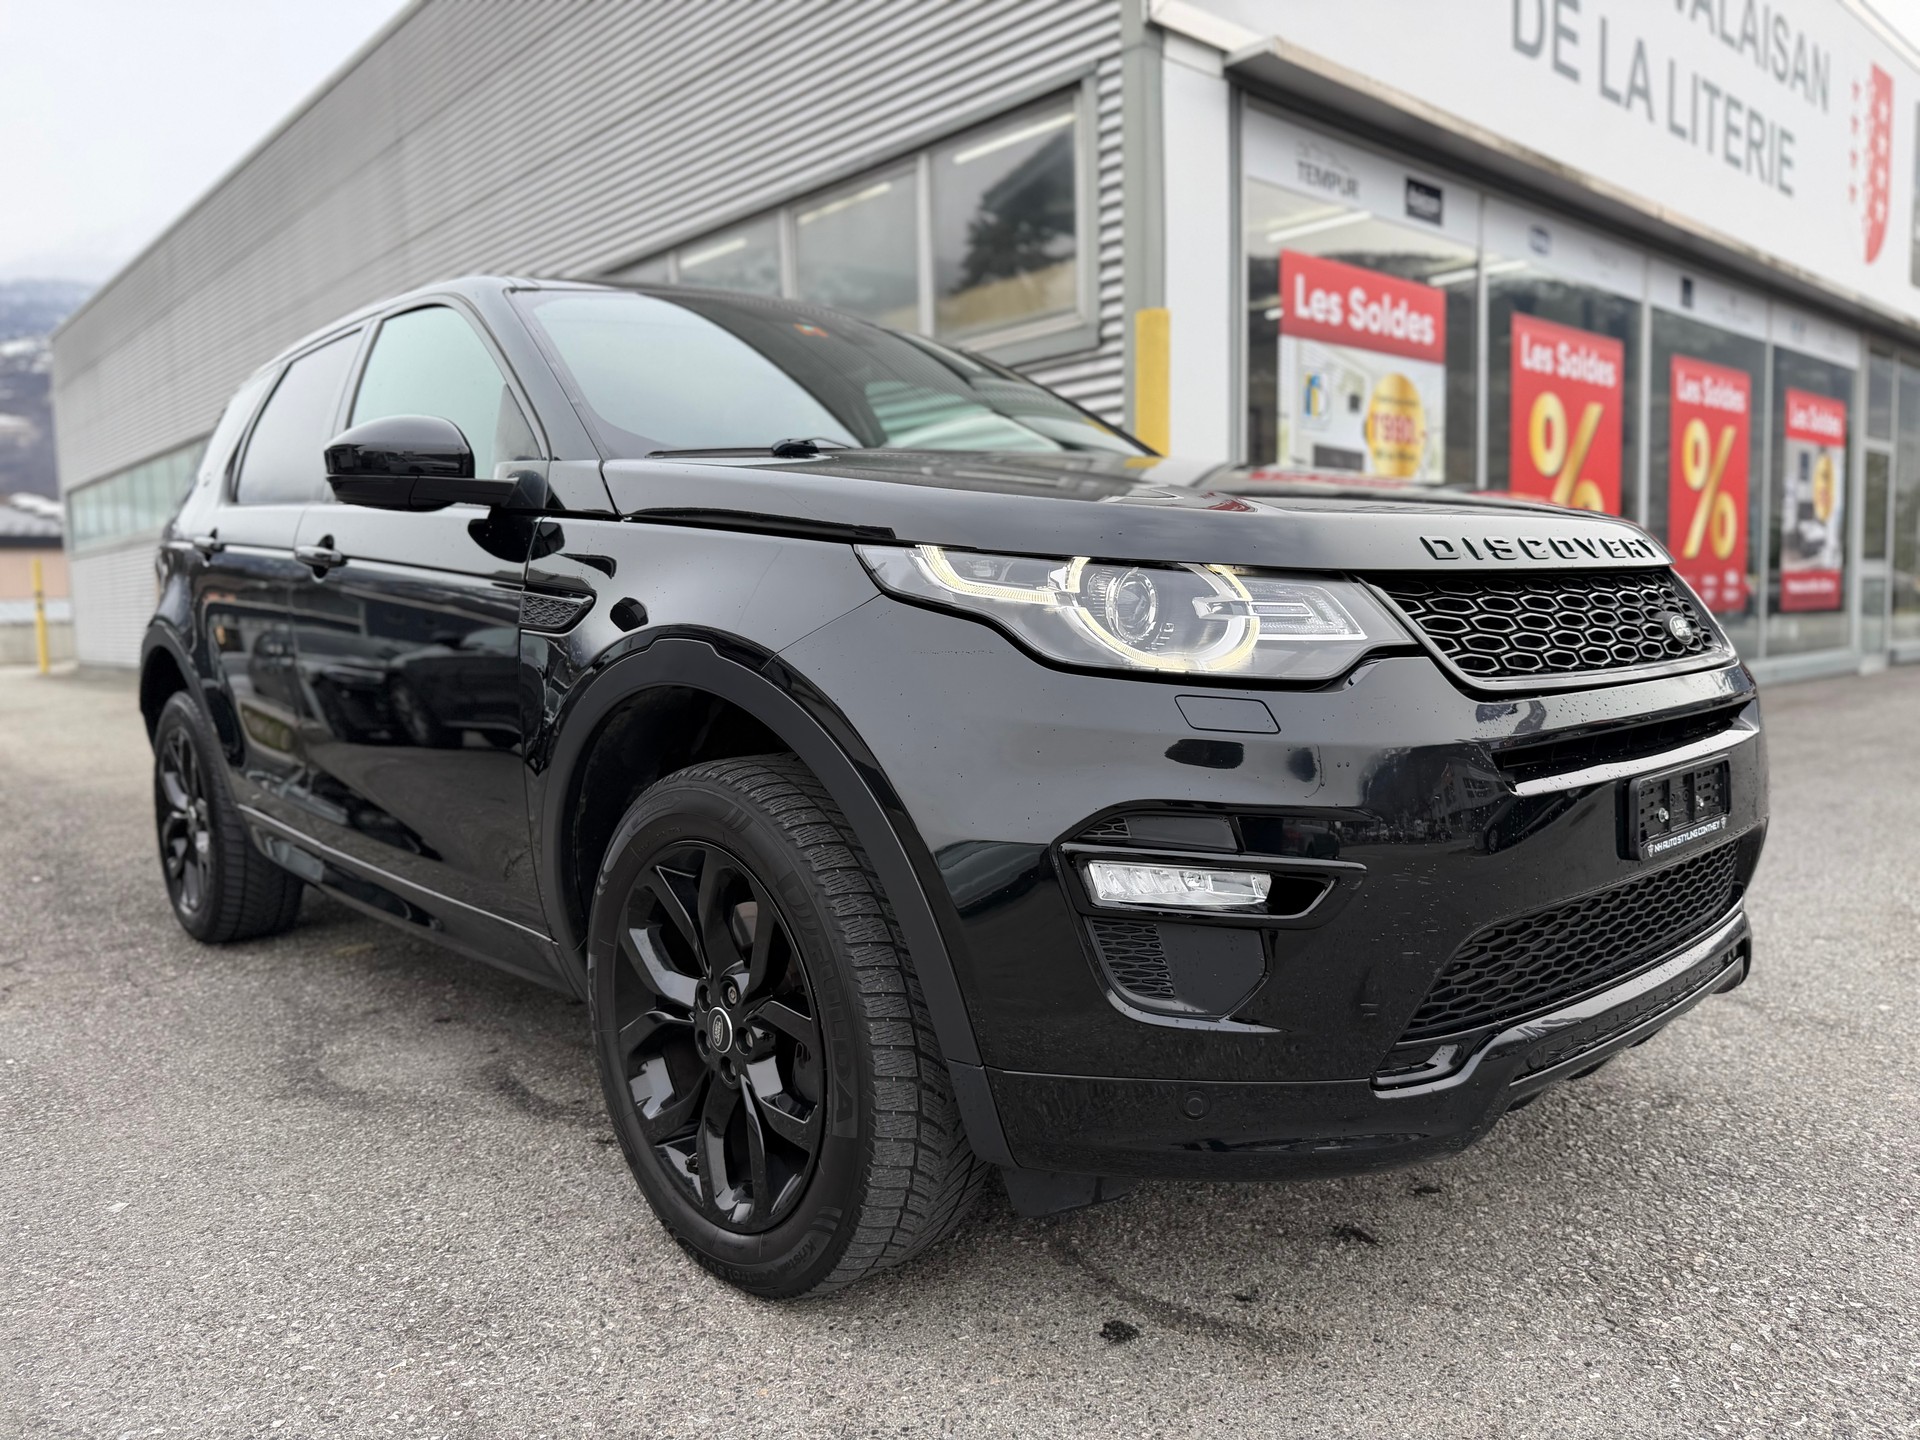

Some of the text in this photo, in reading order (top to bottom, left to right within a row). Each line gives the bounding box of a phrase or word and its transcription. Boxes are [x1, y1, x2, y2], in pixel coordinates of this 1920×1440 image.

[1674, 0, 1831, 114] LAISAN
[1599, 15, 1655, 124] LA
[1668, 57, 1796, 198] LITERIE
[1297, 159, 1359, 199] TEMPUR
[1294, 273, 1435, 346] Les Soldes
[1521, 332, 1616, 388] Les Soldes
[1676, 370, 1746, 414] Les Soldes
[1681, 418, 1737, 561] %
[1419, 535, 1657, 560] DISCOVERY
[1677, 829, 1698, 845] STYLING
